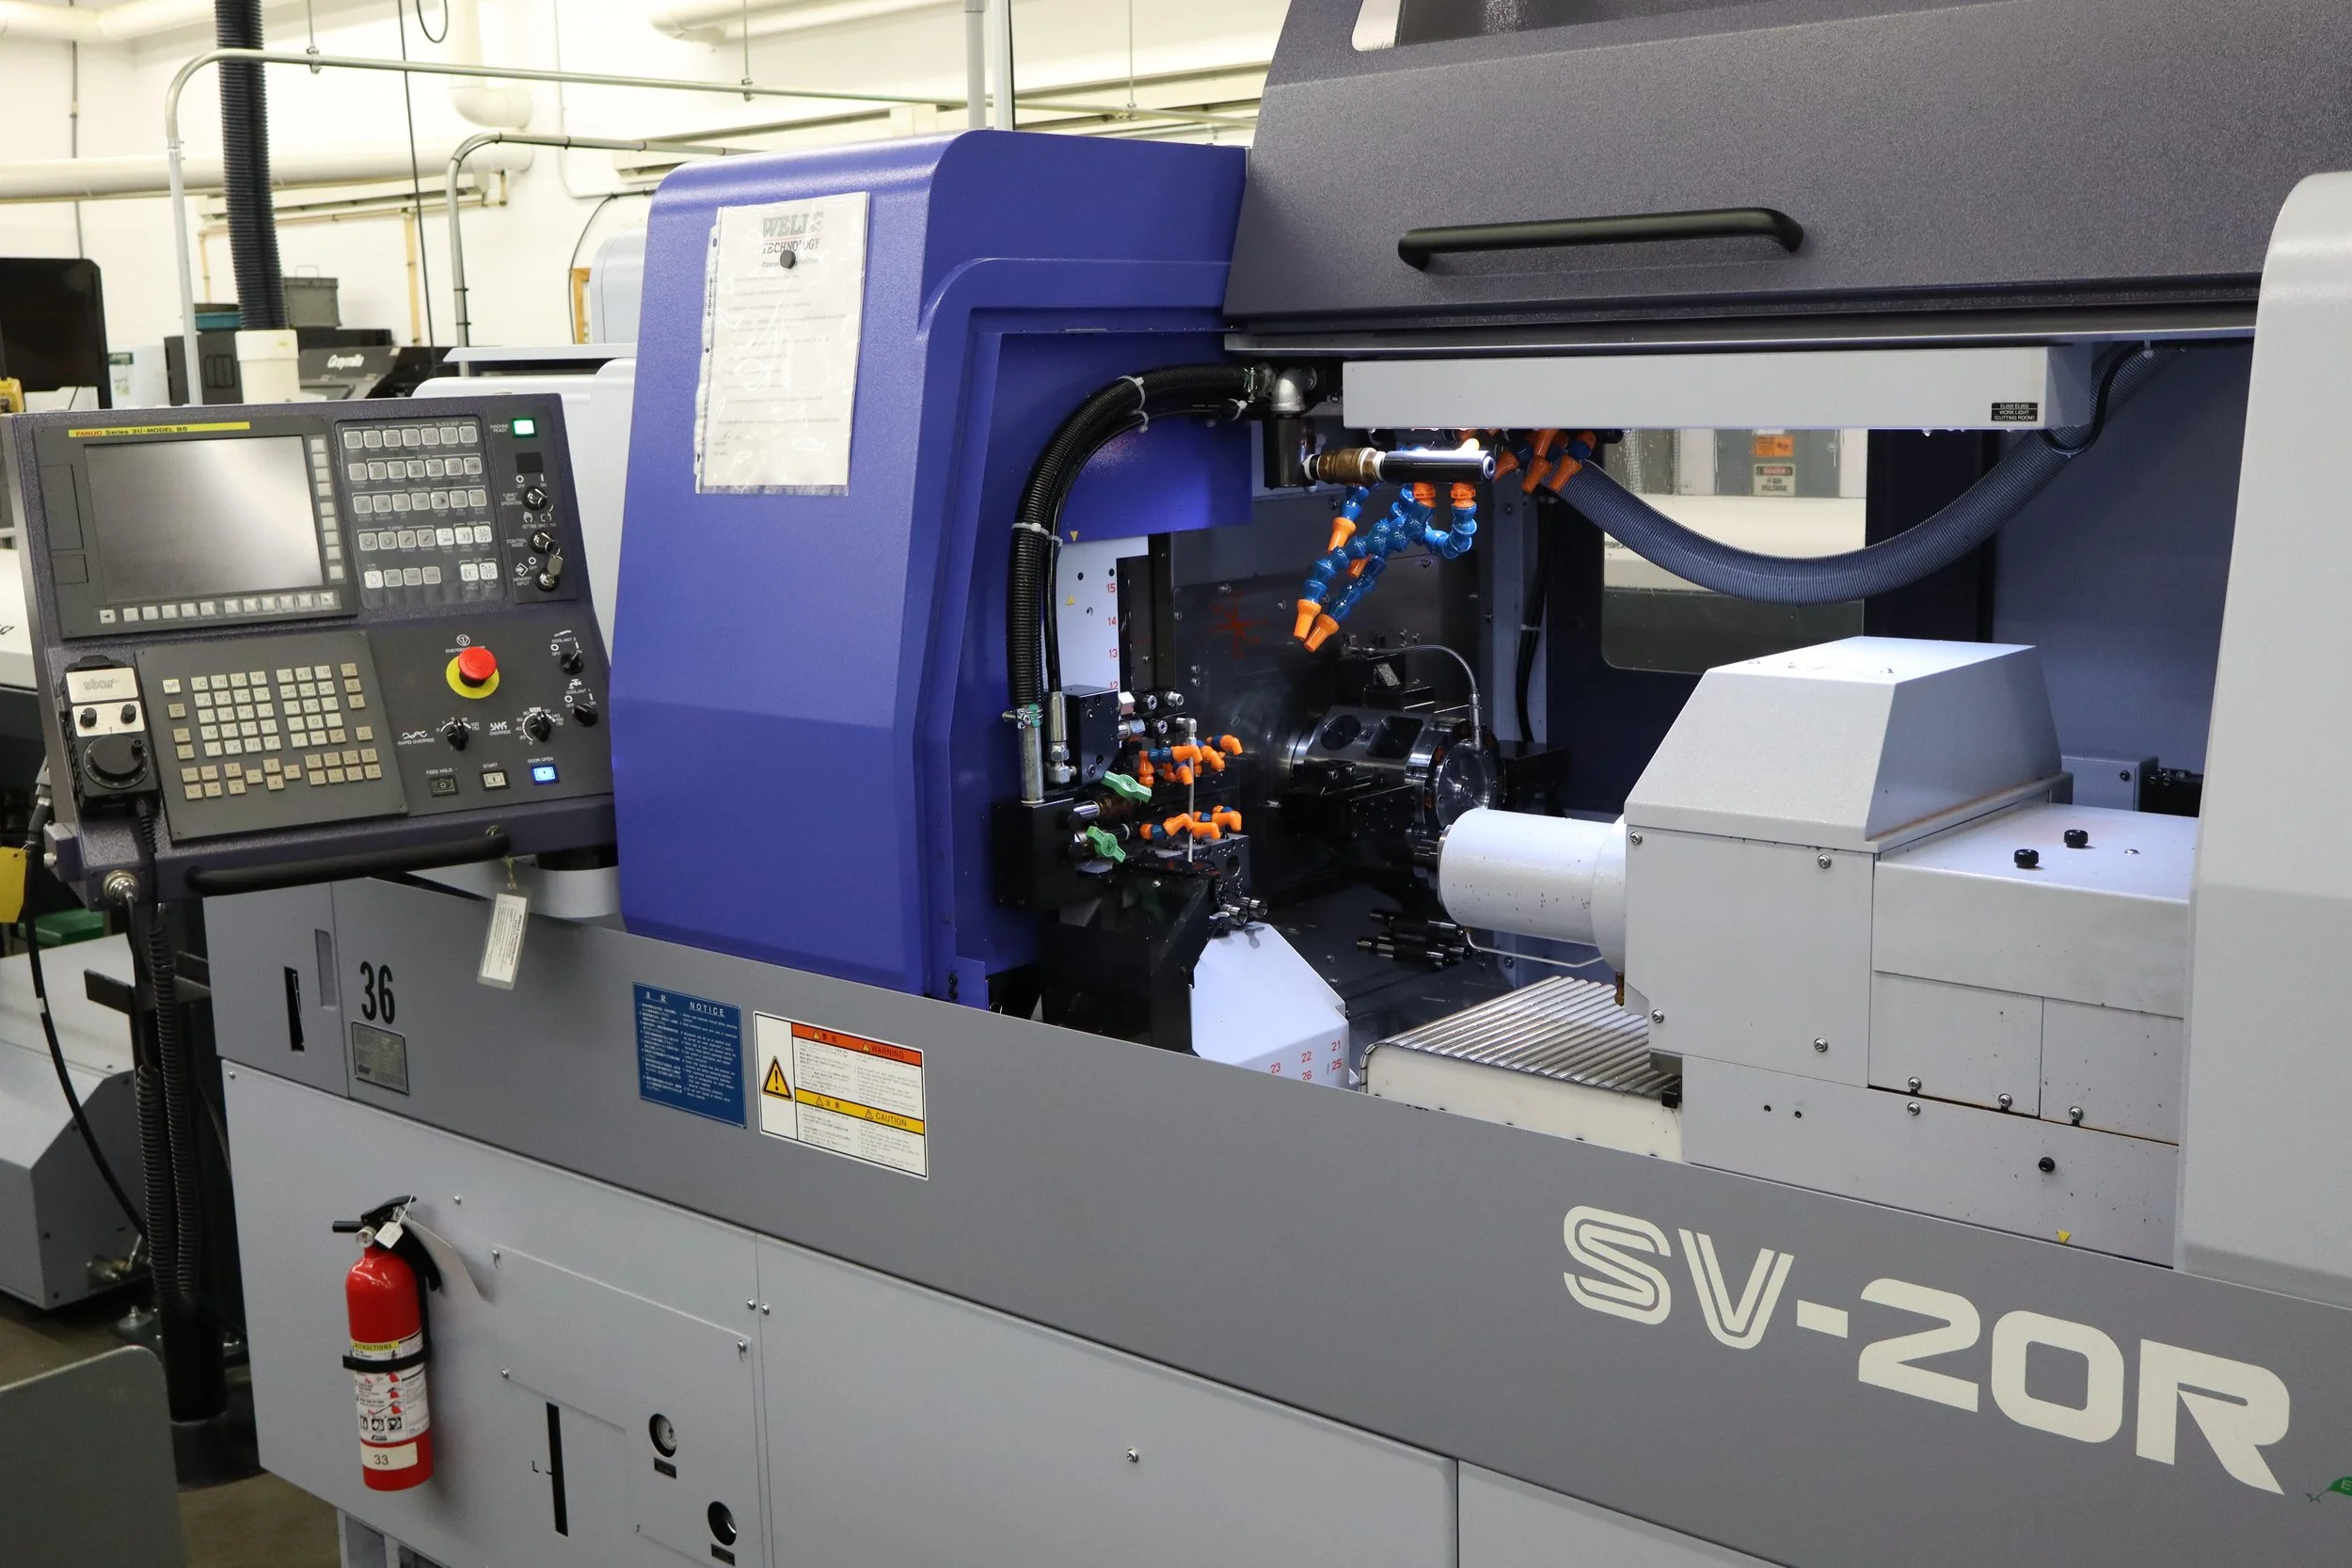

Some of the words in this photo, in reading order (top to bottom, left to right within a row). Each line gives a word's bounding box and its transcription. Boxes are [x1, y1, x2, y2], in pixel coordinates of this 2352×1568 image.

[1106, 583, 1116, 593] 15
[1107, 616, 1117, 626] 14
[1108, 648, 1118, 658] 13
[359, 960, 396, 1024] 36
[690, 1001, 724, 1016] NOTICE
[871, 1045, 904, 1059] WARNING
[1332, 1040, 1341, 1052] 21
[1301, 1051, 1311, 1063] 22
[1271, 1063, 1280, 1073] 23
[1302, 1070, 1311, 1081] 26
[1332, 1058, 1342, 1070] 25
[876, 1113, 907, 1127] CAUTION
[1562, 1203, 2293, 1497] SV-20R
[374, 1455, 389, 1465] 33
